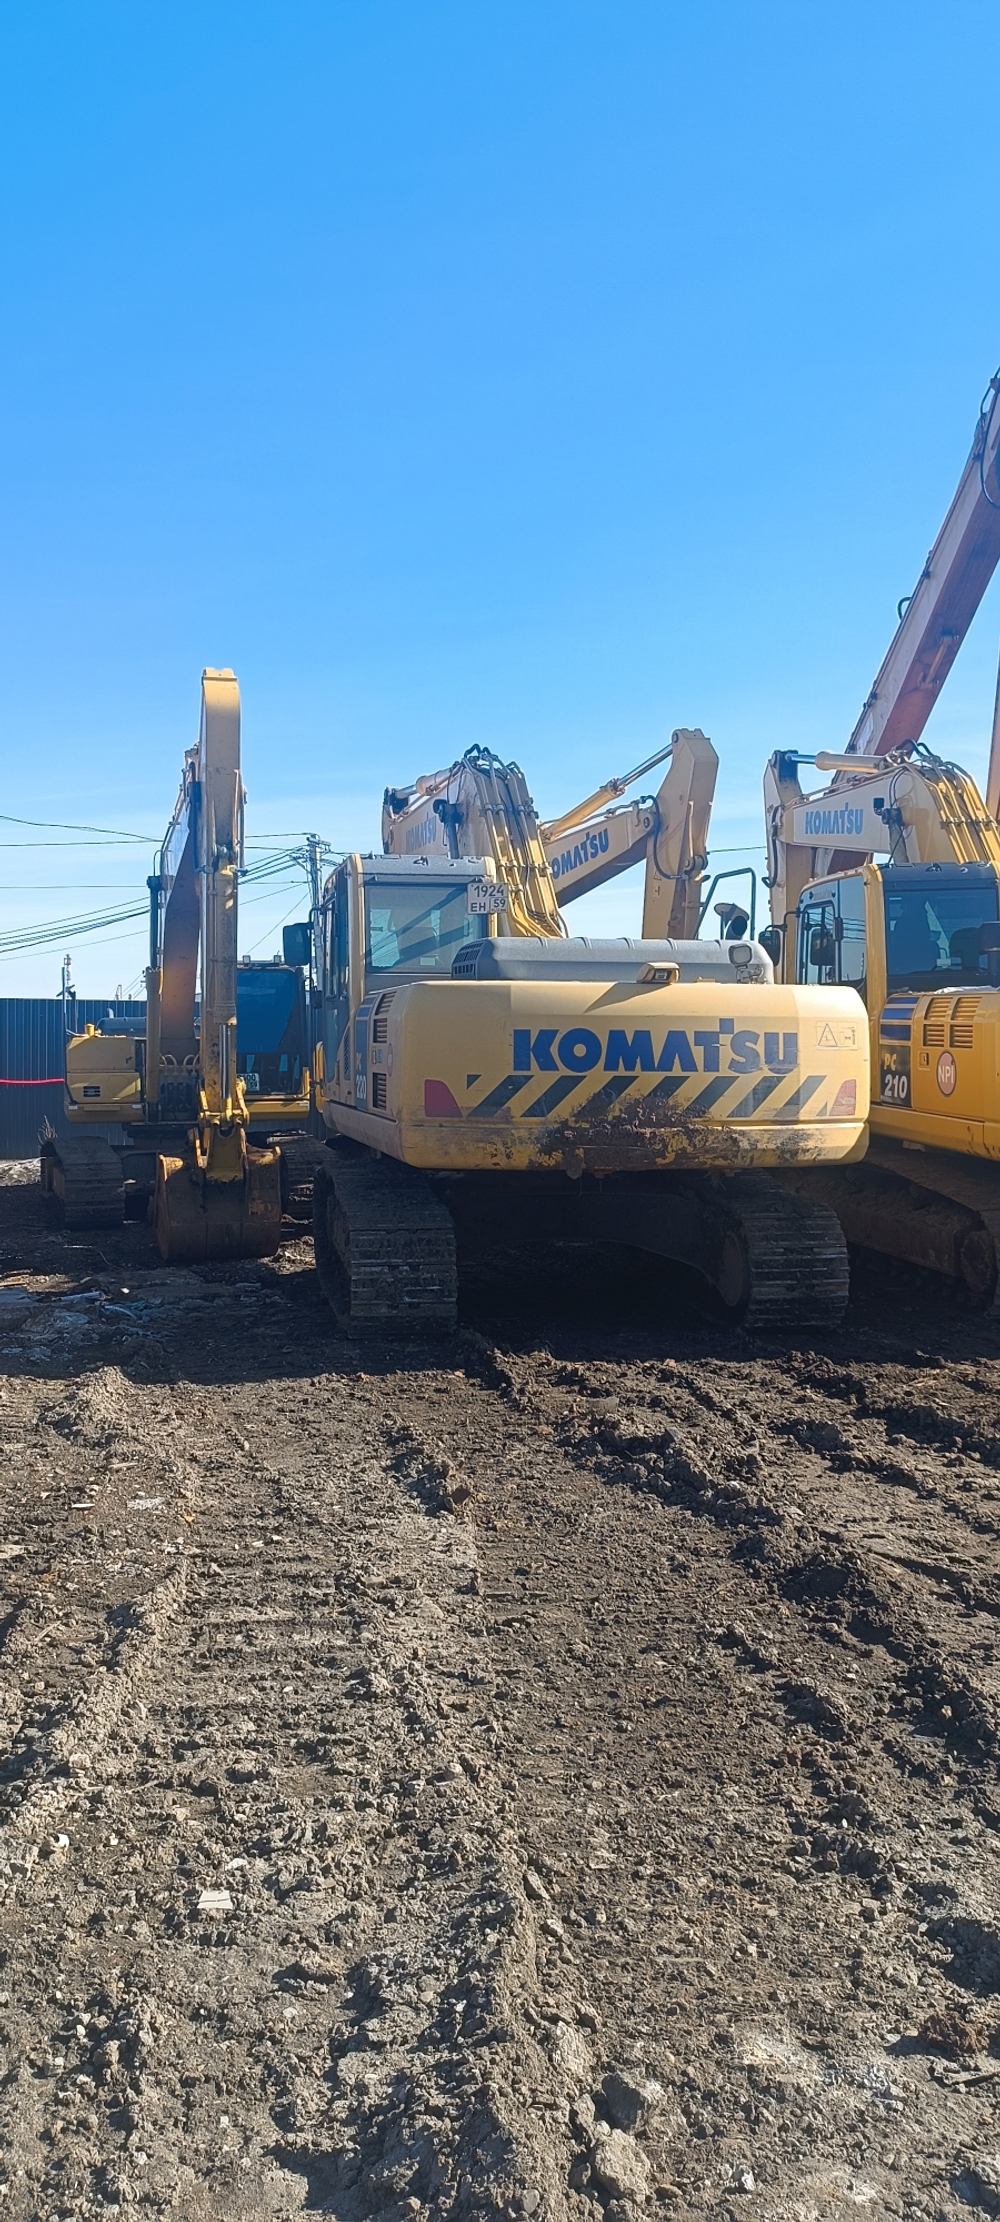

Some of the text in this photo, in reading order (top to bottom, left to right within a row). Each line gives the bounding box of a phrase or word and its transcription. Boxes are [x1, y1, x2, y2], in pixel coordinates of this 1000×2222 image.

[805, 802, 864, 835] KOMATSU
[551, 828, 609, 880] OMATSU
[474, 885, 504, 898] 1924
[493, 898, 506, 908] 59
[512, 1017, 799, 1075] KOMATSU
[883, 1053, 897, 1071] PC
[938, 1065, 954, 1084] NPI
[356, 1074, 367, 1100] 220
[884, 1074, 908, 1099] 210
